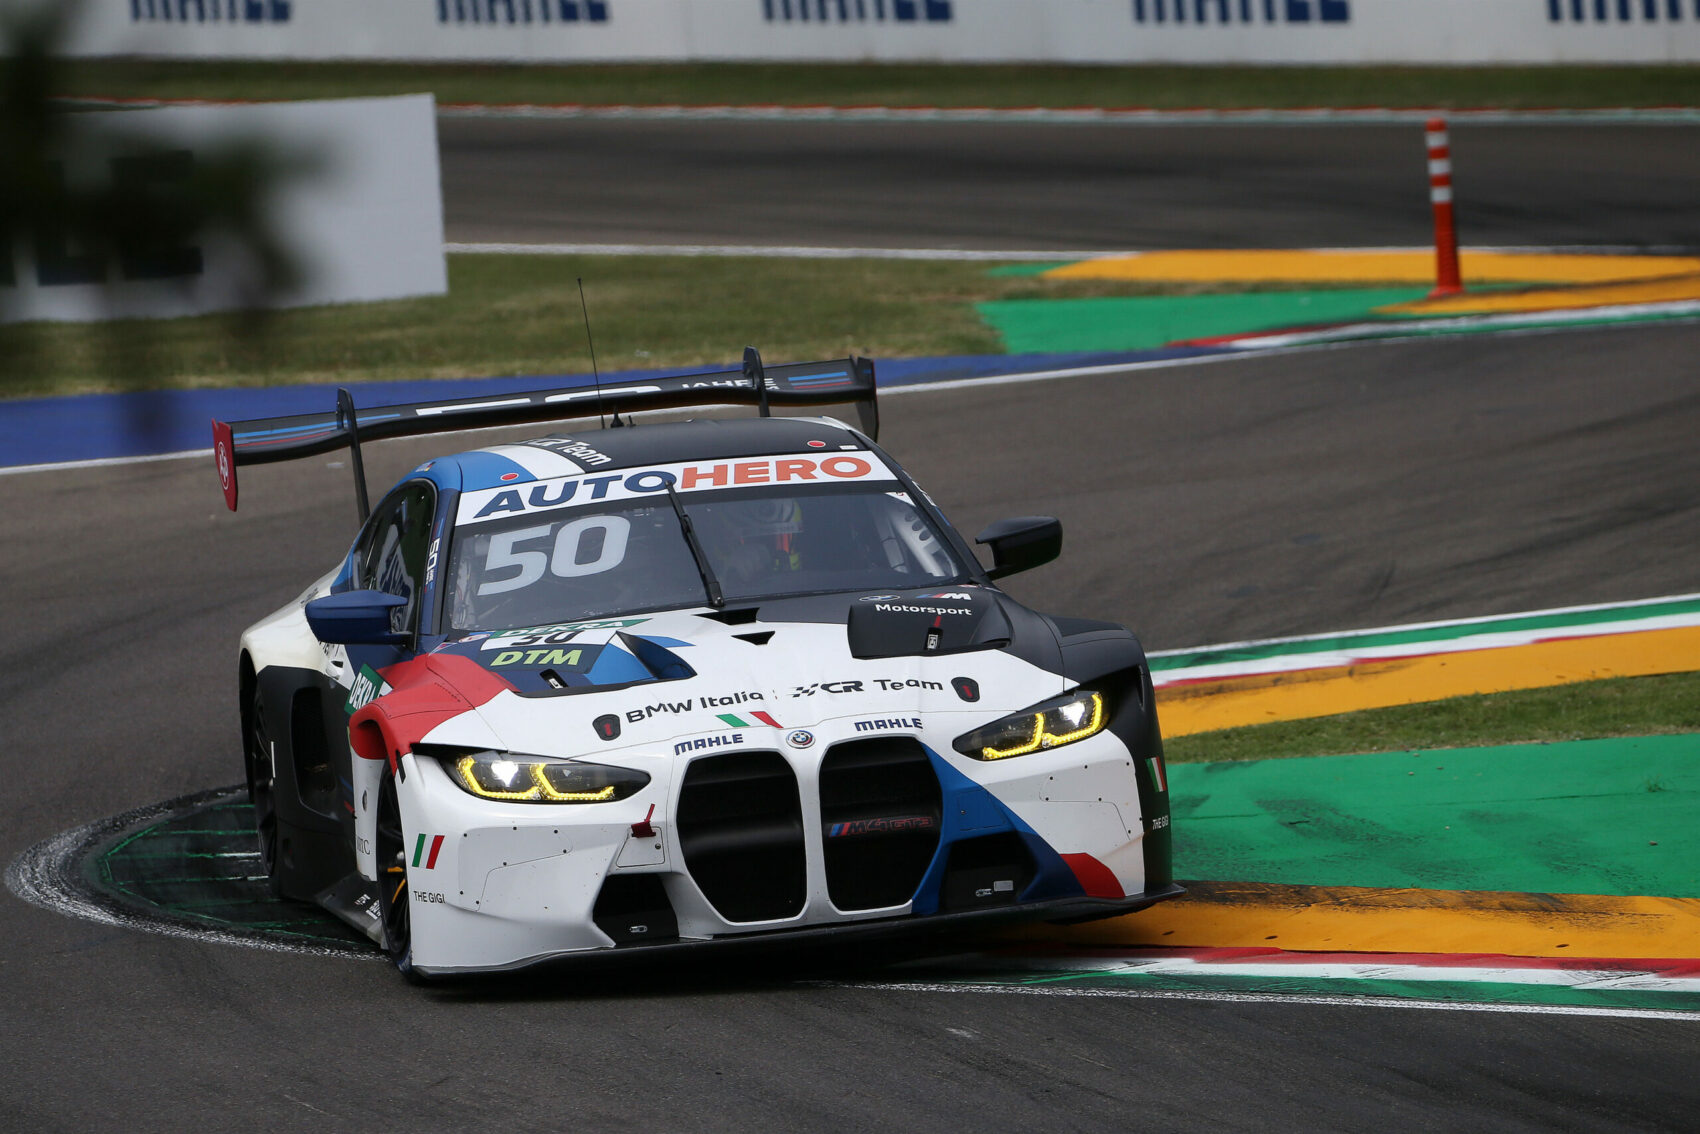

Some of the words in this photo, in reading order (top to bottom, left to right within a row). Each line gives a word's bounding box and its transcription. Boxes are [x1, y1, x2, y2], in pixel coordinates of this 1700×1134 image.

[557, 441, 612, 466] Team
[473, 456, 872, 519] AUTOHERO
[427, 537, 441, 572] 50
[477, 515, 632, 596] 50
[875, 603, 973, 616] Motorsport
[490, 649, 582, 667] DTM
[625, 699, 693, 724] BMW
[700, 690, 764, 709] Italia
[873, 678, 944, 691] Team
[853, 717, 924, 732] MAHLE
[673, 733, 744, 756] MAHLE
[413, 889, 428, 903] THE
